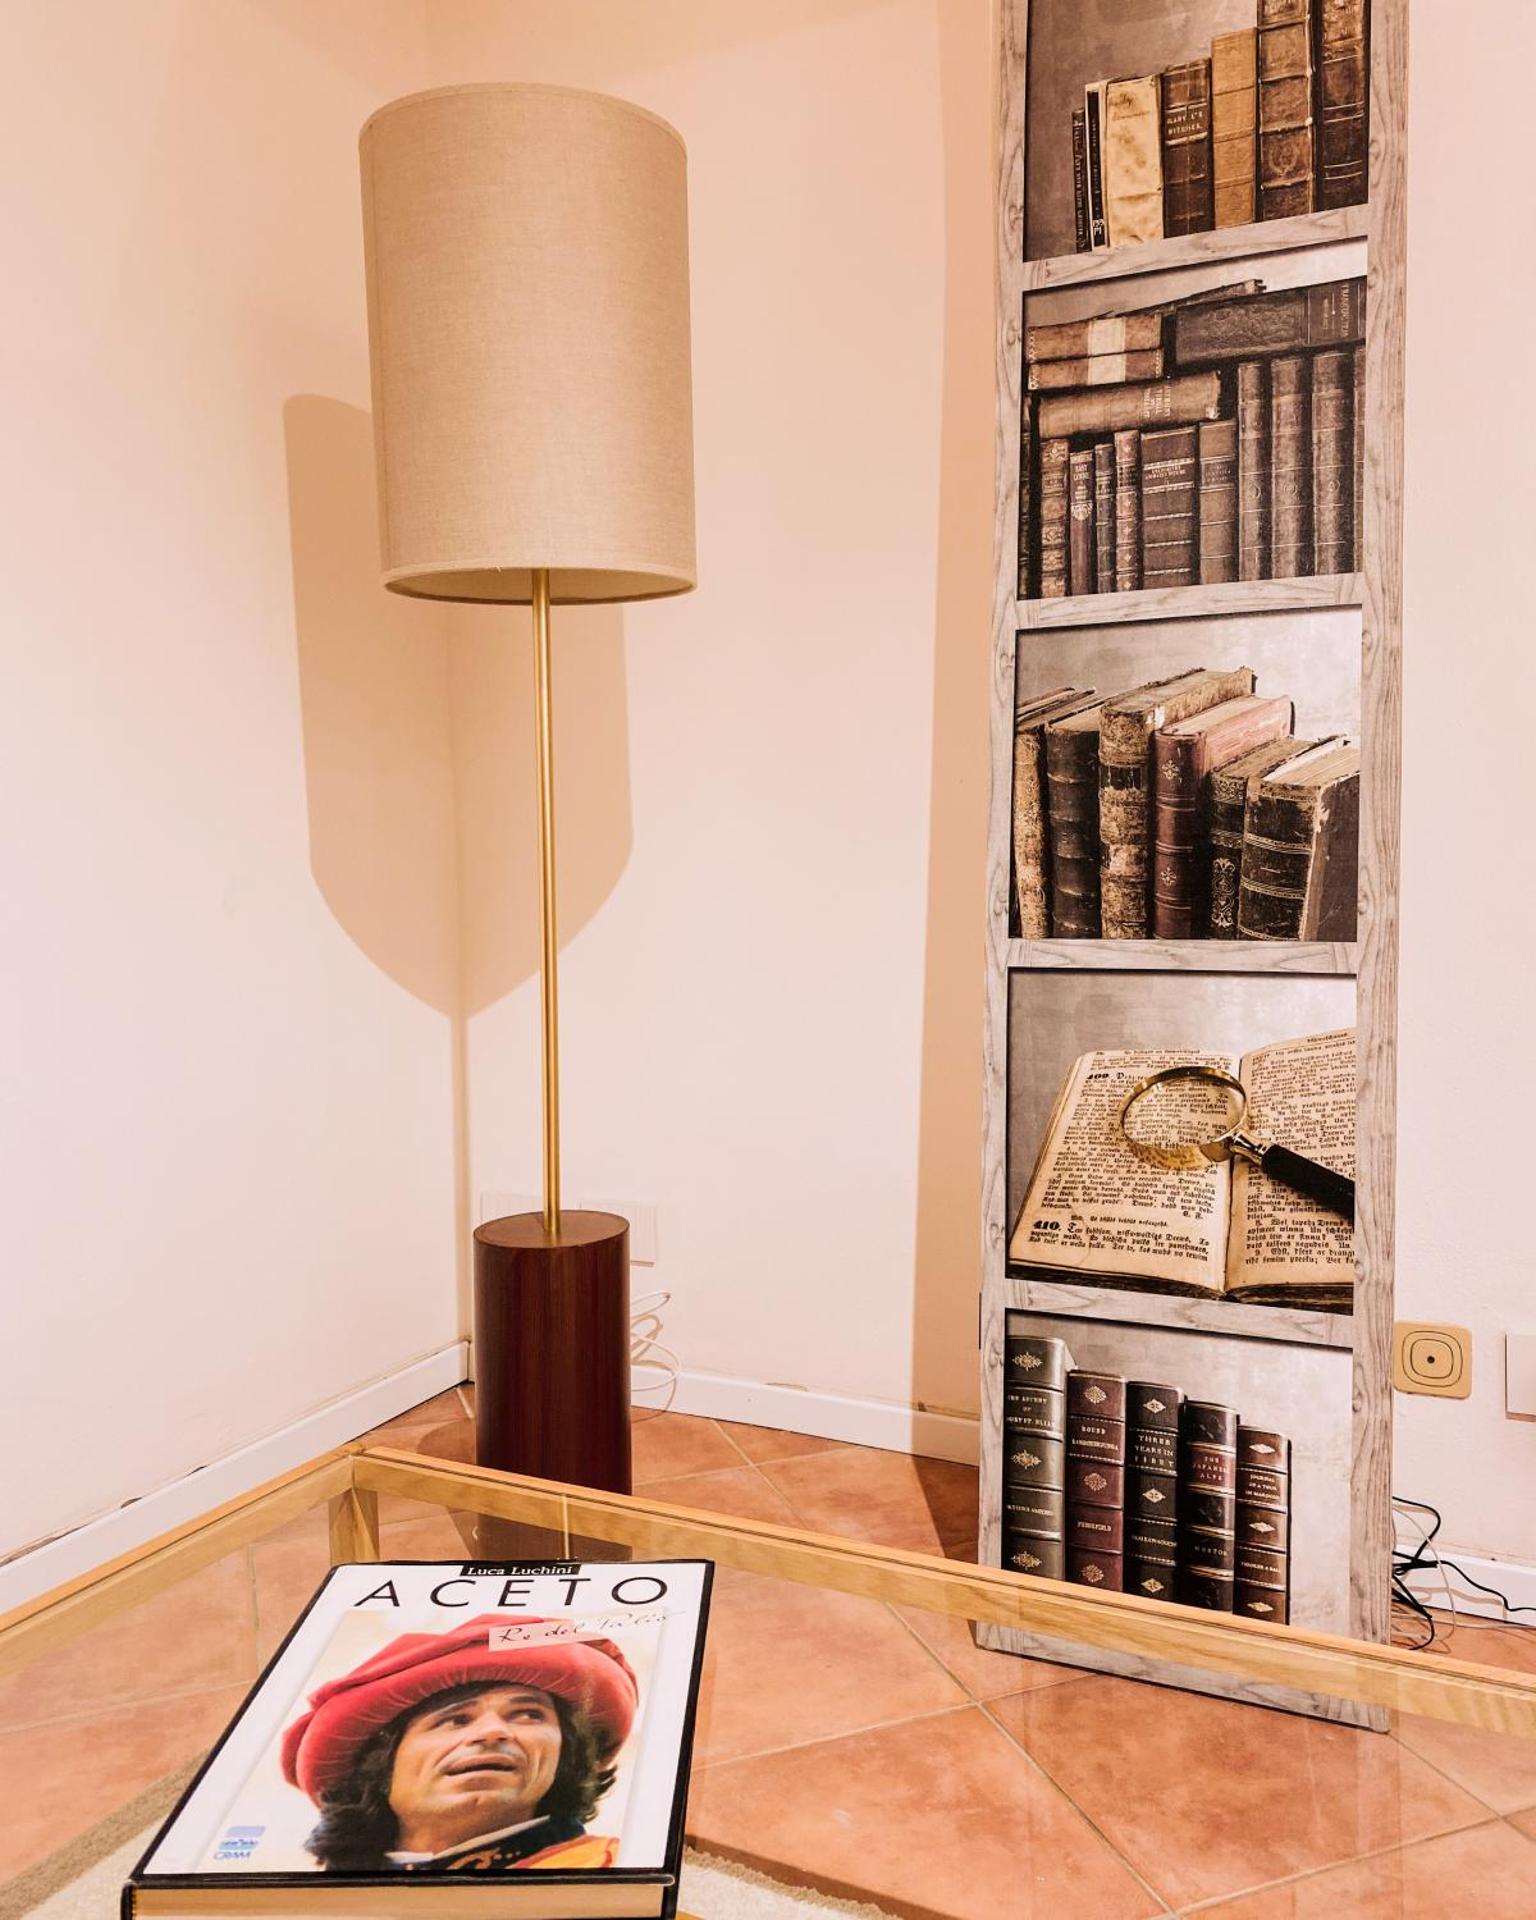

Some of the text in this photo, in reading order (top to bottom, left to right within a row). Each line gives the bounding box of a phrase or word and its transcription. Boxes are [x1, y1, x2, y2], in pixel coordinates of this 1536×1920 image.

[467, 1565, 573, 1576] Luca Luchini
[354, 1576, 668, 1608] ACETO
[498, 1627, 531, 1642] Re
[544, 1621, 585, 1638] del
